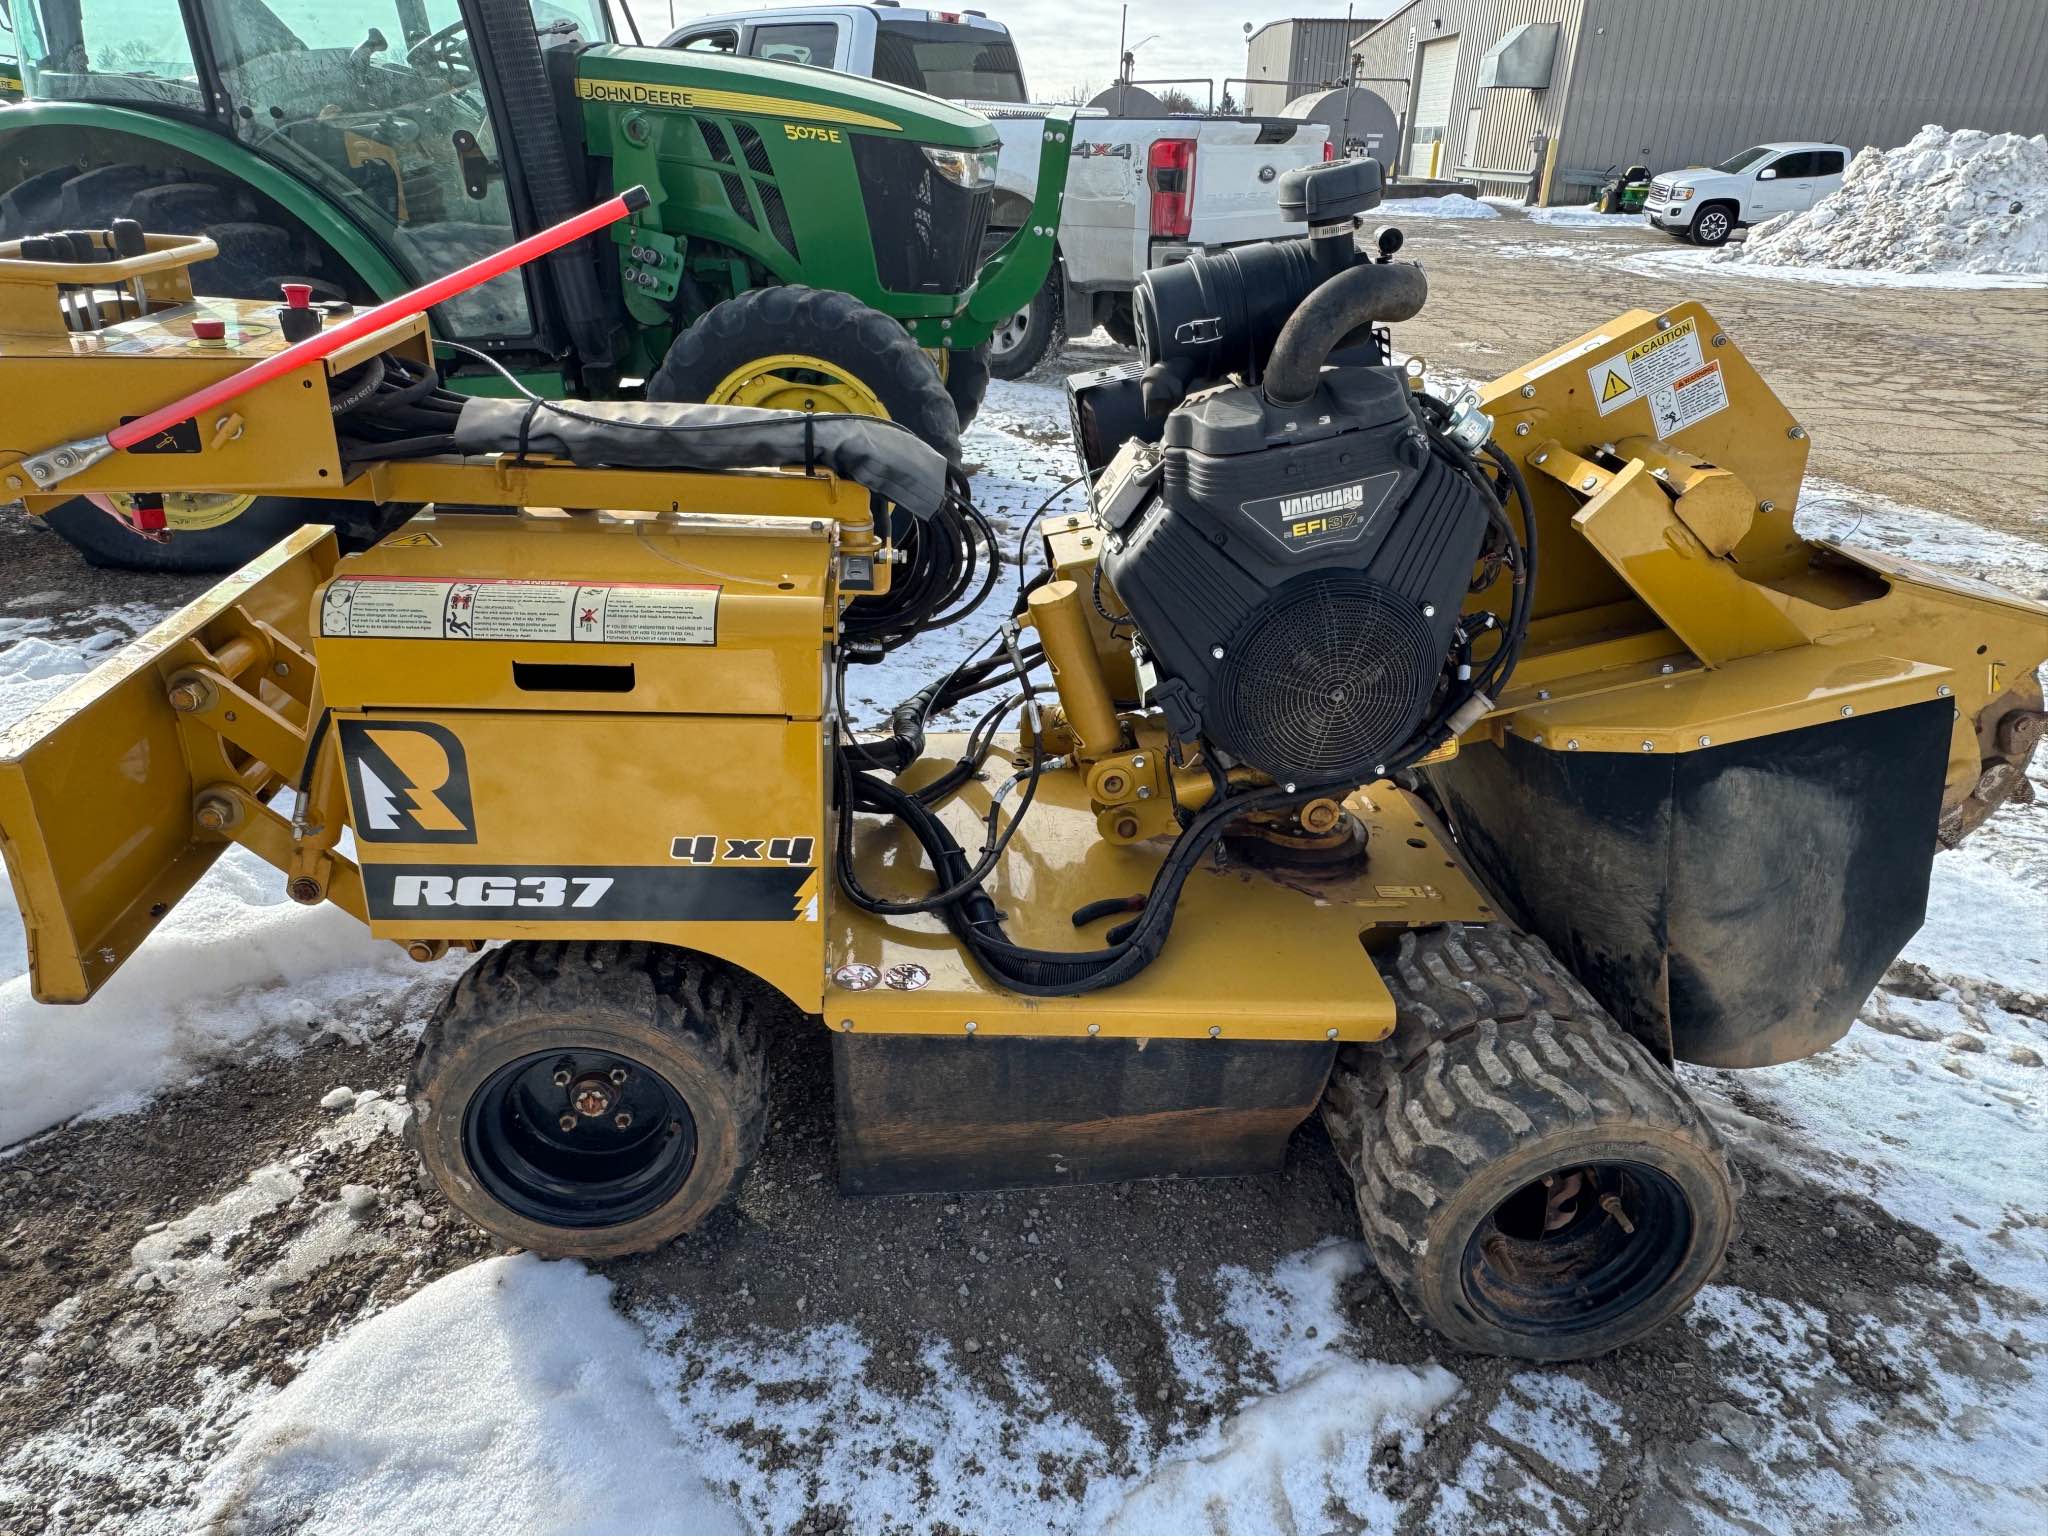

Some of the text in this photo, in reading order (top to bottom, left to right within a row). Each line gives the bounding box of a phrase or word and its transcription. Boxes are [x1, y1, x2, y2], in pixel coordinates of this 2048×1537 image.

[585, 82, 693, 107] JOHN DEERE
[784, 124, 842, 144] 5075E
[1641, 323, 1691, 354] CAUTION
[1280, 484, 1363, 516] VANGUARD
[511, 579, 569, 587] DANGER
[392, 875, 614, 908] RG37
